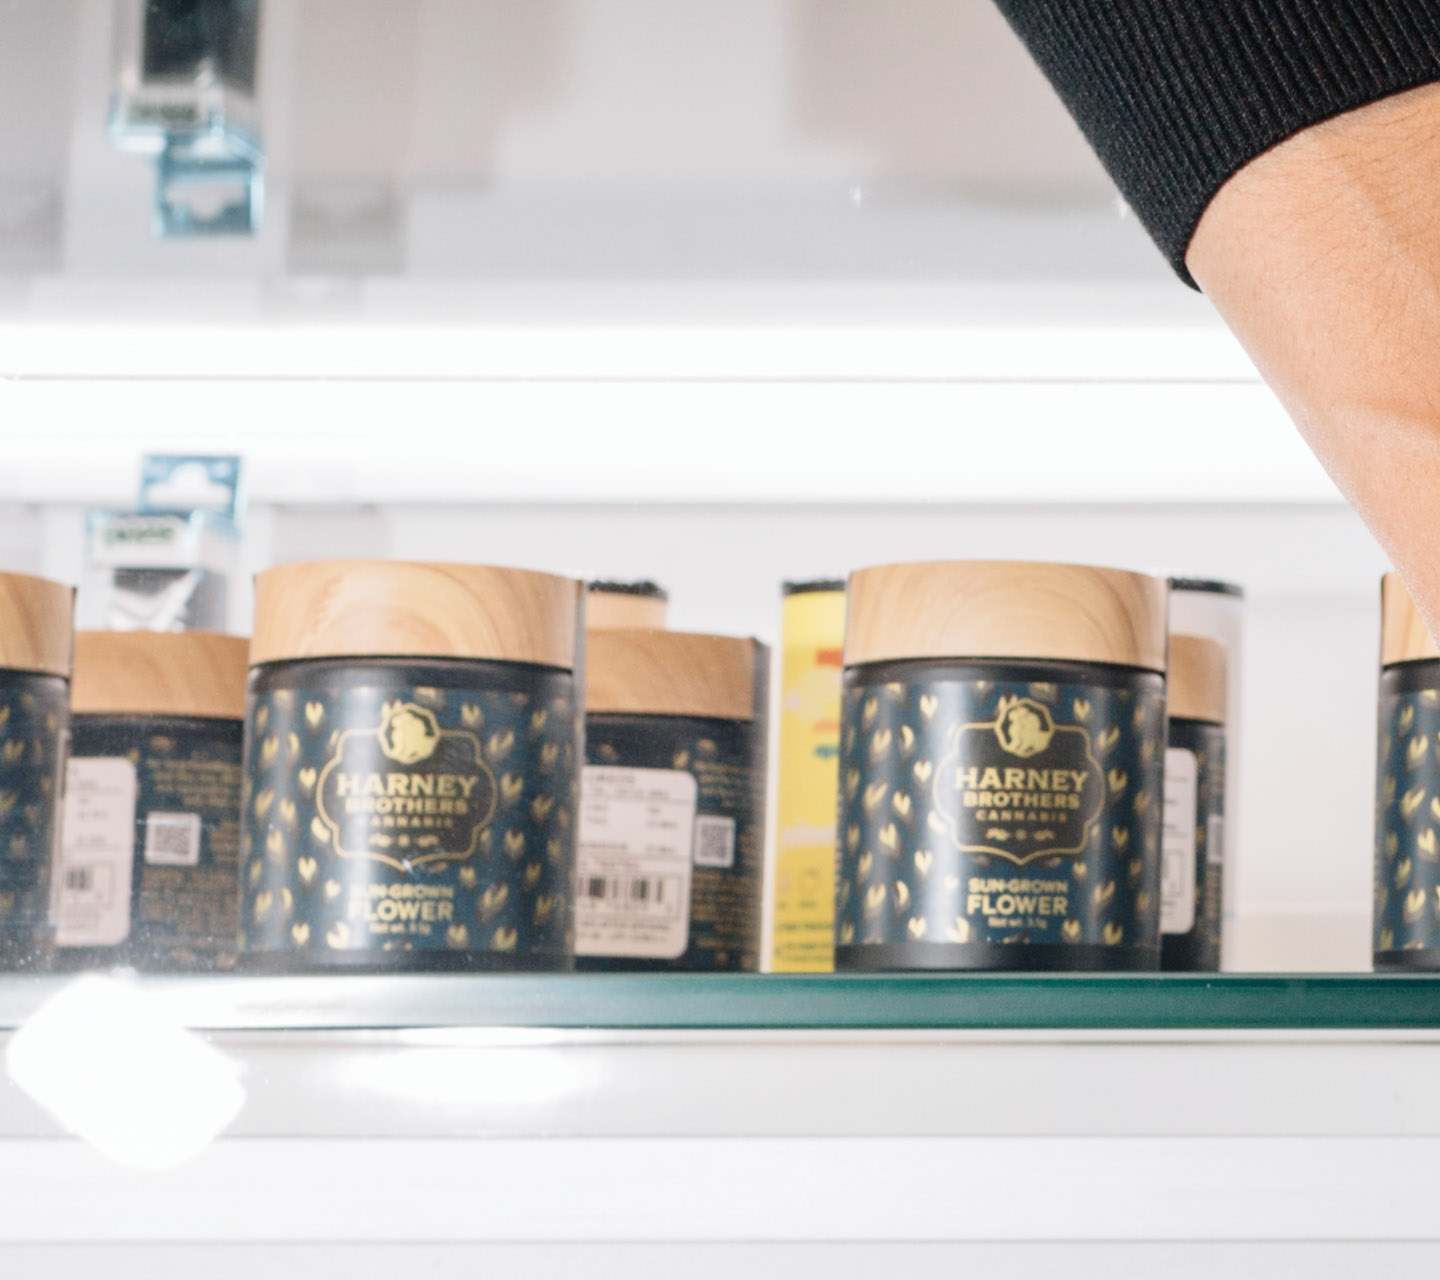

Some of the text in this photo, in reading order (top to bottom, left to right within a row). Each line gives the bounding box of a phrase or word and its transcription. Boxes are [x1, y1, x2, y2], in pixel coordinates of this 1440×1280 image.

[336, 772, 479, 797] HARNEY
[954, 766, 1090, 793] HARNEY
[345, 796, 469, 814] BROTHERS
[962, 791, 1081, 809] BROTHERS
[975, 810, 1068, 822] CANNABIS
[967, 877, 1069, 894] SUN-GROWN
[347, 899, 455, 921] FLOWER
[966, 893, 1069, 917] FLOWER
